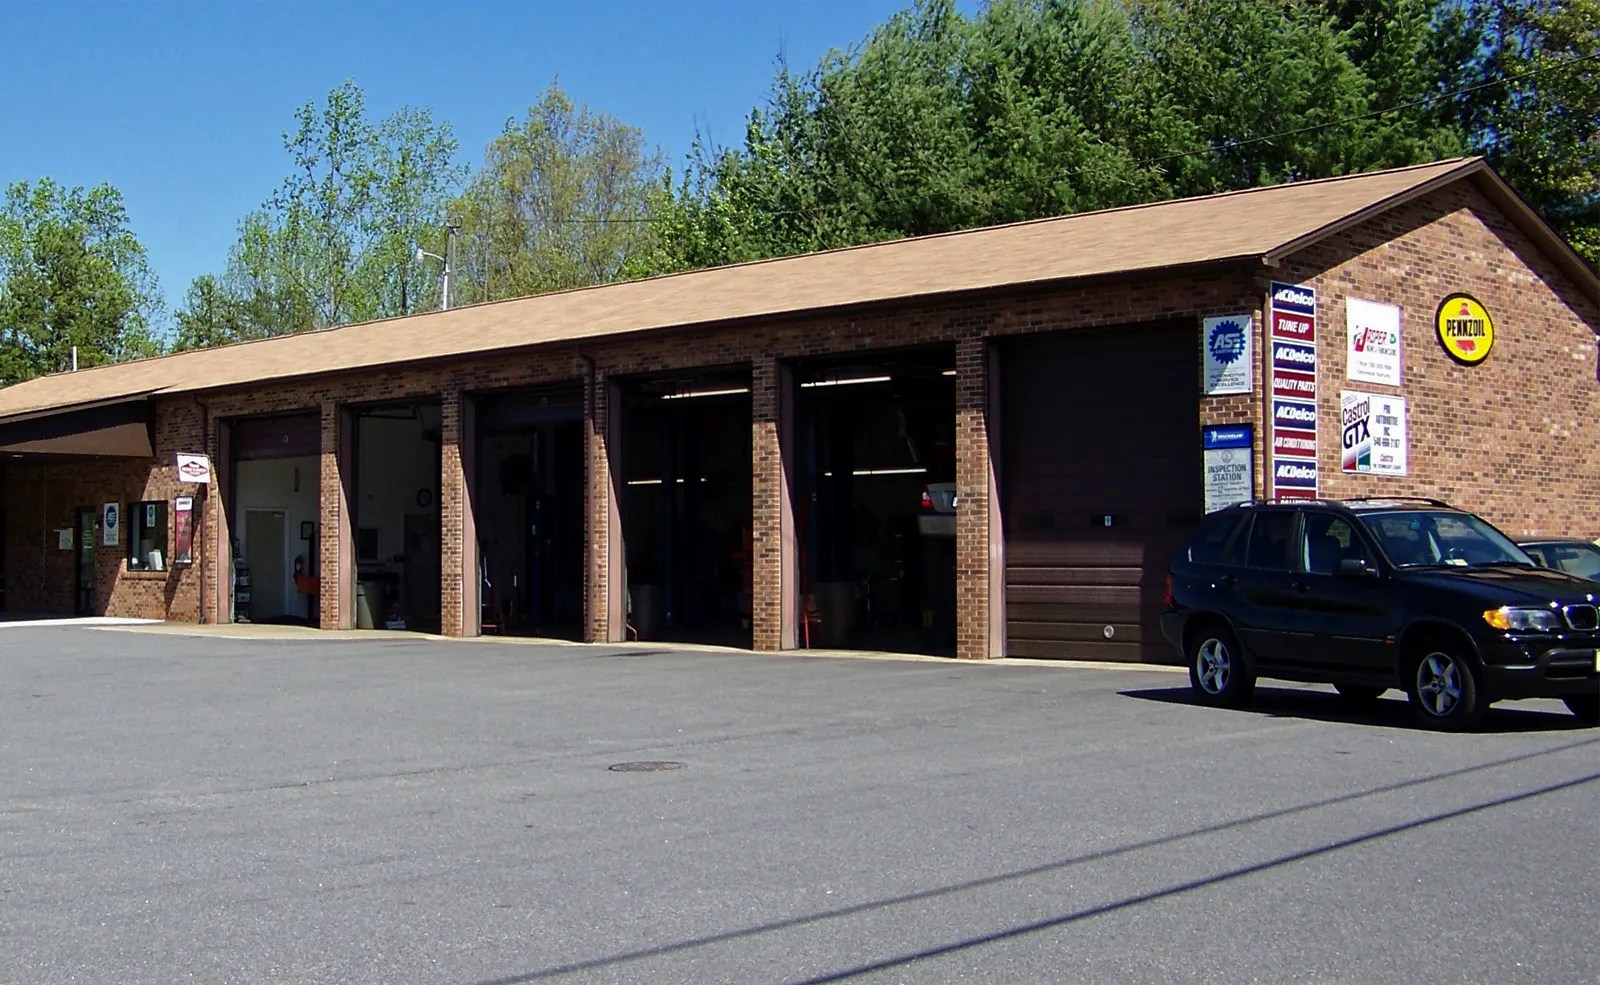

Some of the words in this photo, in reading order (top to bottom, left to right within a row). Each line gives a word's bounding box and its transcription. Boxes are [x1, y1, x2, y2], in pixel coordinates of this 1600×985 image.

[1274, 289, 1315, 306] ACDelco
[1278, 319, 1298, 333] TUNE
[1298, 322, 1310, 334] UP
[1446, 318, 1486, 337] PENNZOIL
[1213, 332, 1241, 350] ASE
[1275, 347, 1316, 364] ACDelco
[1274, 377, 1297, 390] QUALITY
[1297, 380, 1316, 393] PARTS
[1275, 406, 1316, 422] ACDelco
[1342, 396, 1371, 427] Castrol
[1343, 415, 1370, 449] GTX
[1207, 463, 1248, 474] INSPECTION
[1276, 465, 1317, 480] ACDelco
[1212, 472, 1243, 482] STATION
